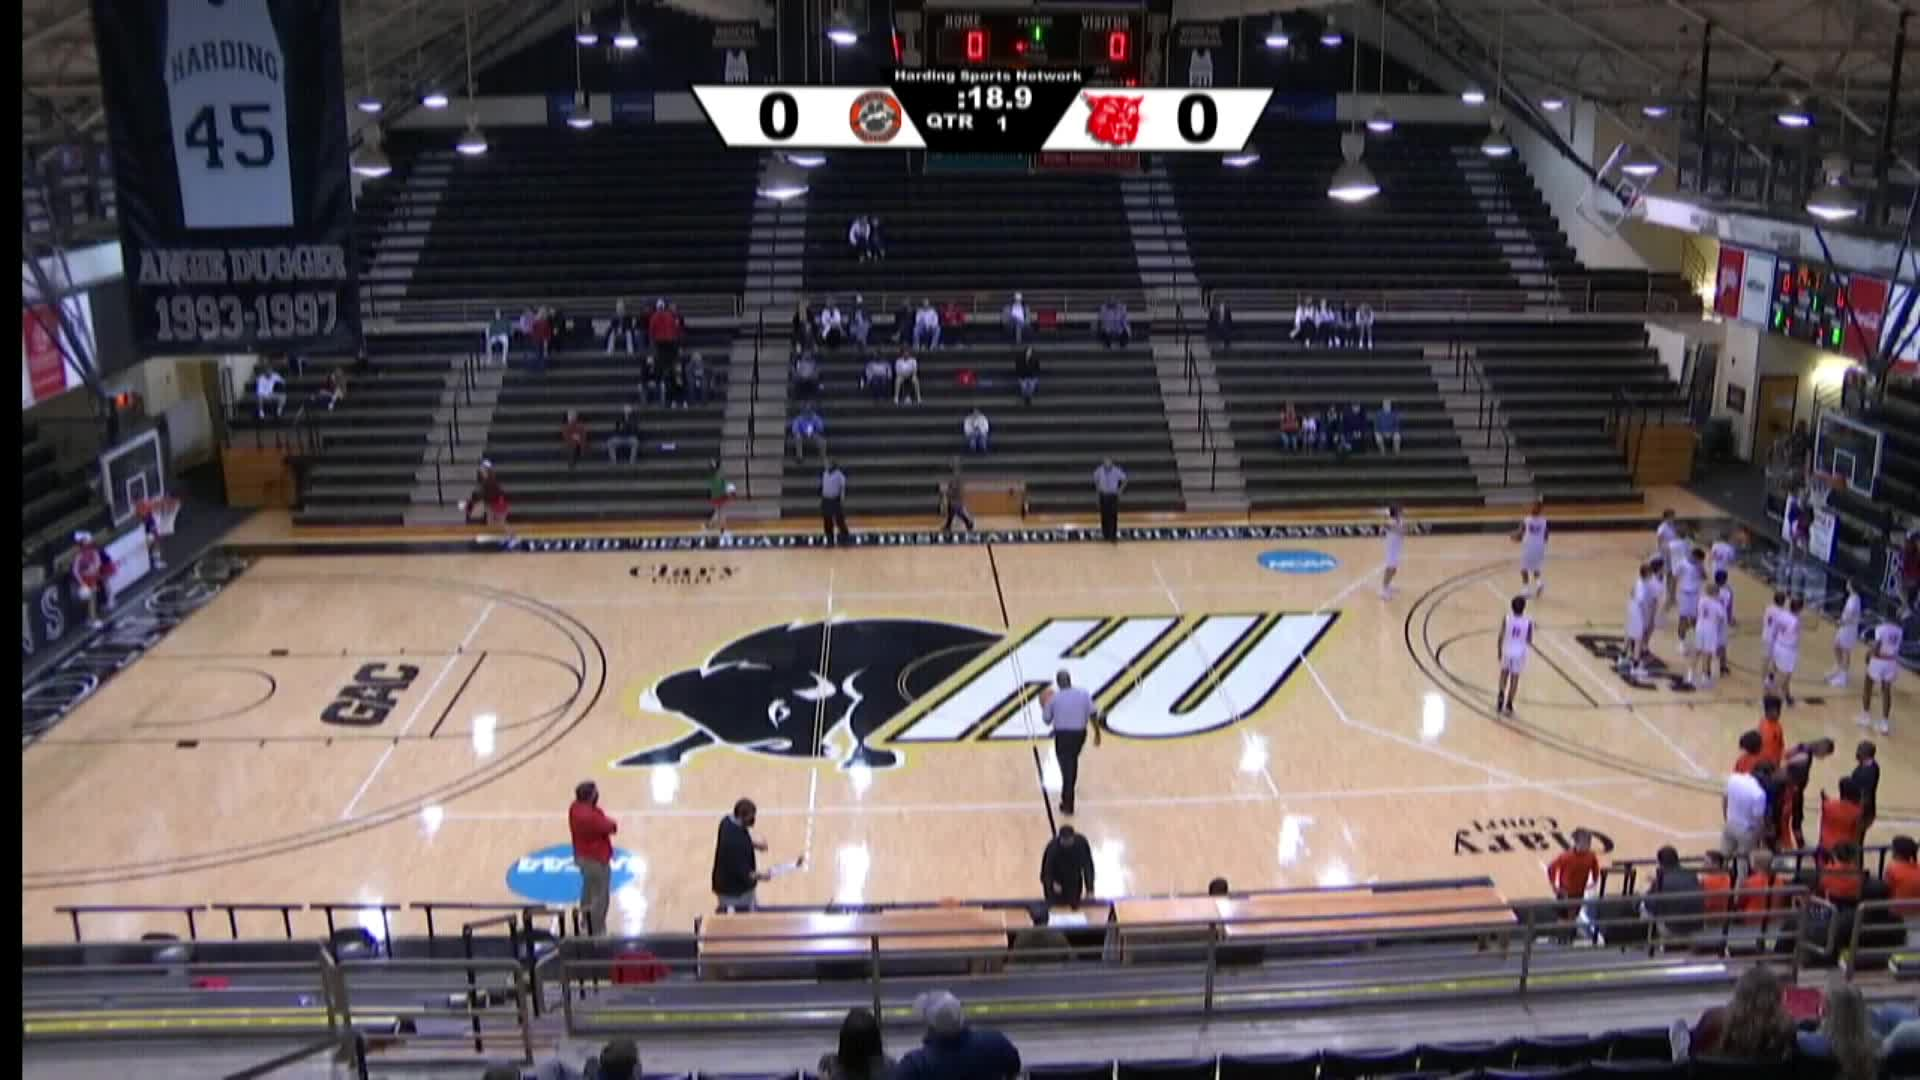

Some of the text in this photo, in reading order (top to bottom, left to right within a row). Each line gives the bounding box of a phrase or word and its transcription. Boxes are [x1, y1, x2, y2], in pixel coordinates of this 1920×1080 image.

[171, 40, 278, 83] HARDING
[967, 31, 983, 60] 0
[1110, 32, 1126, 60] 0
[185, 104, 275, 169] 45
[229, 245, 347, 281] DUGGER
[156, 292, 337, 342] 1993-1997
